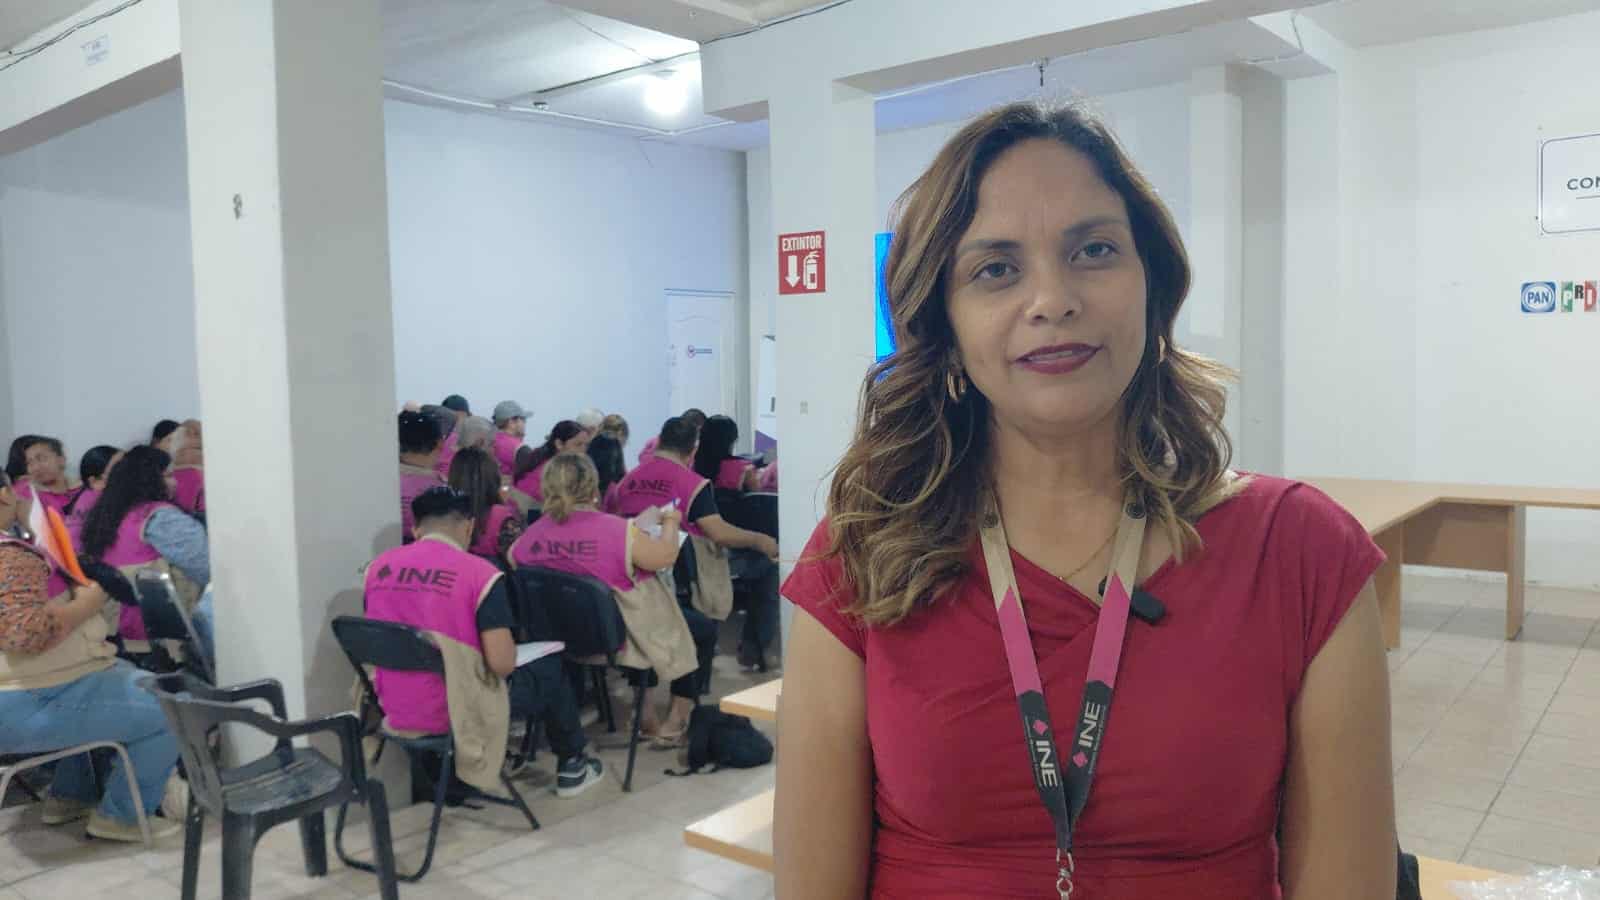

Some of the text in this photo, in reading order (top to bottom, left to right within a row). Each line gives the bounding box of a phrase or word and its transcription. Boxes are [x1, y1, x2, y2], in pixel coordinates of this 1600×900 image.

[782, 234, 822, 252] EXTINTOR
[1528, 291, 1549, 304] PAN
[1562, 283, 1597, 310] PRD
[641, 479, 673, 491] INE
[547, 540, 597, 558] INE
[397, 567, 458, 589] INE
[1078, 701, 1101, 748] INE
[1035, 740, 1058, 787] INE
